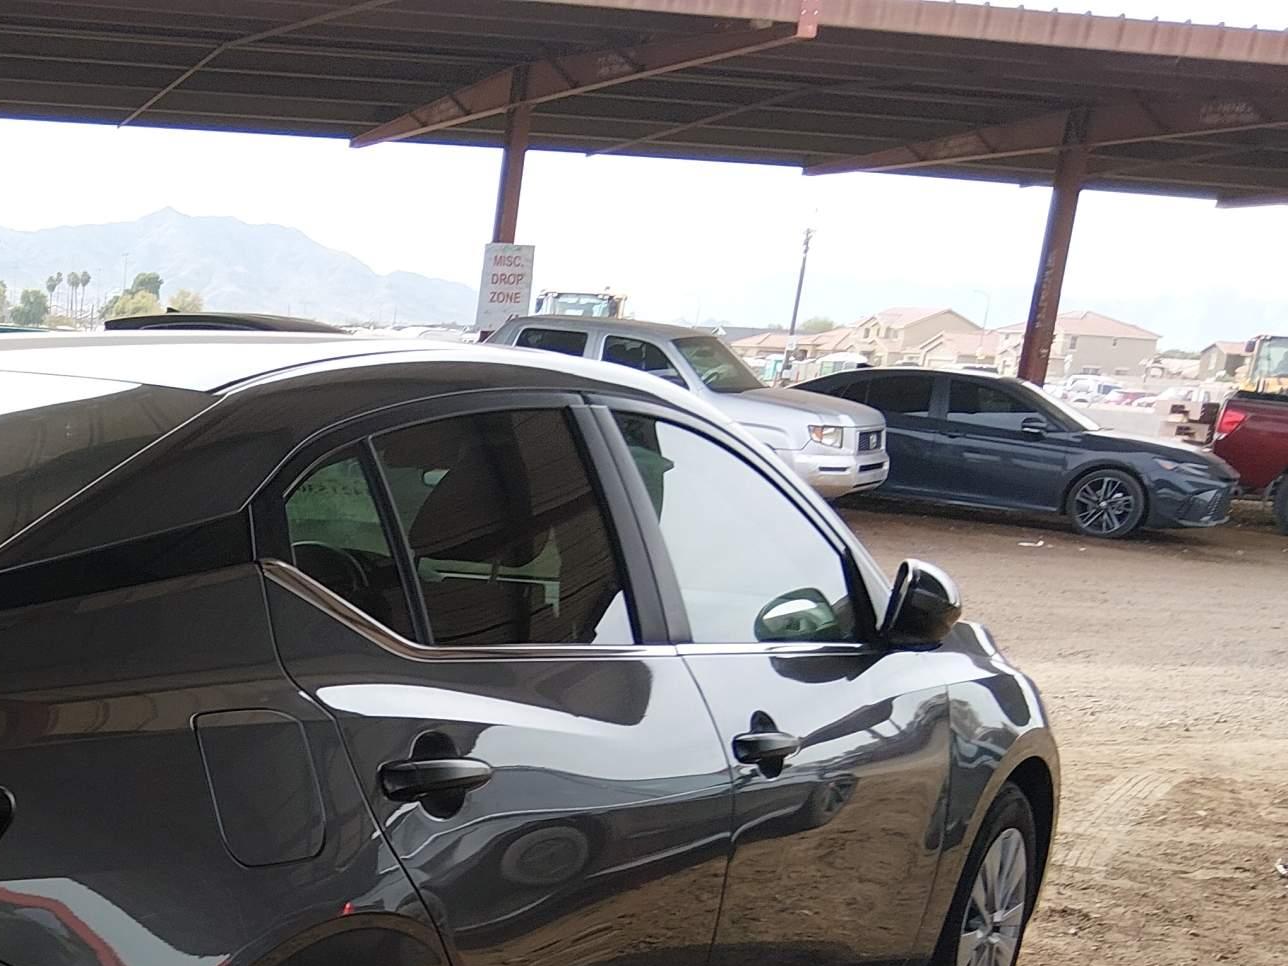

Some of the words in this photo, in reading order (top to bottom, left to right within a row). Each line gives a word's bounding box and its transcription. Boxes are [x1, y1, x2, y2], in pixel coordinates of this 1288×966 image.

[493, 255, 524, 268] MISC.
[491, 273, 524, 286] DROP
[488, 291, 521, 304] ZONE
